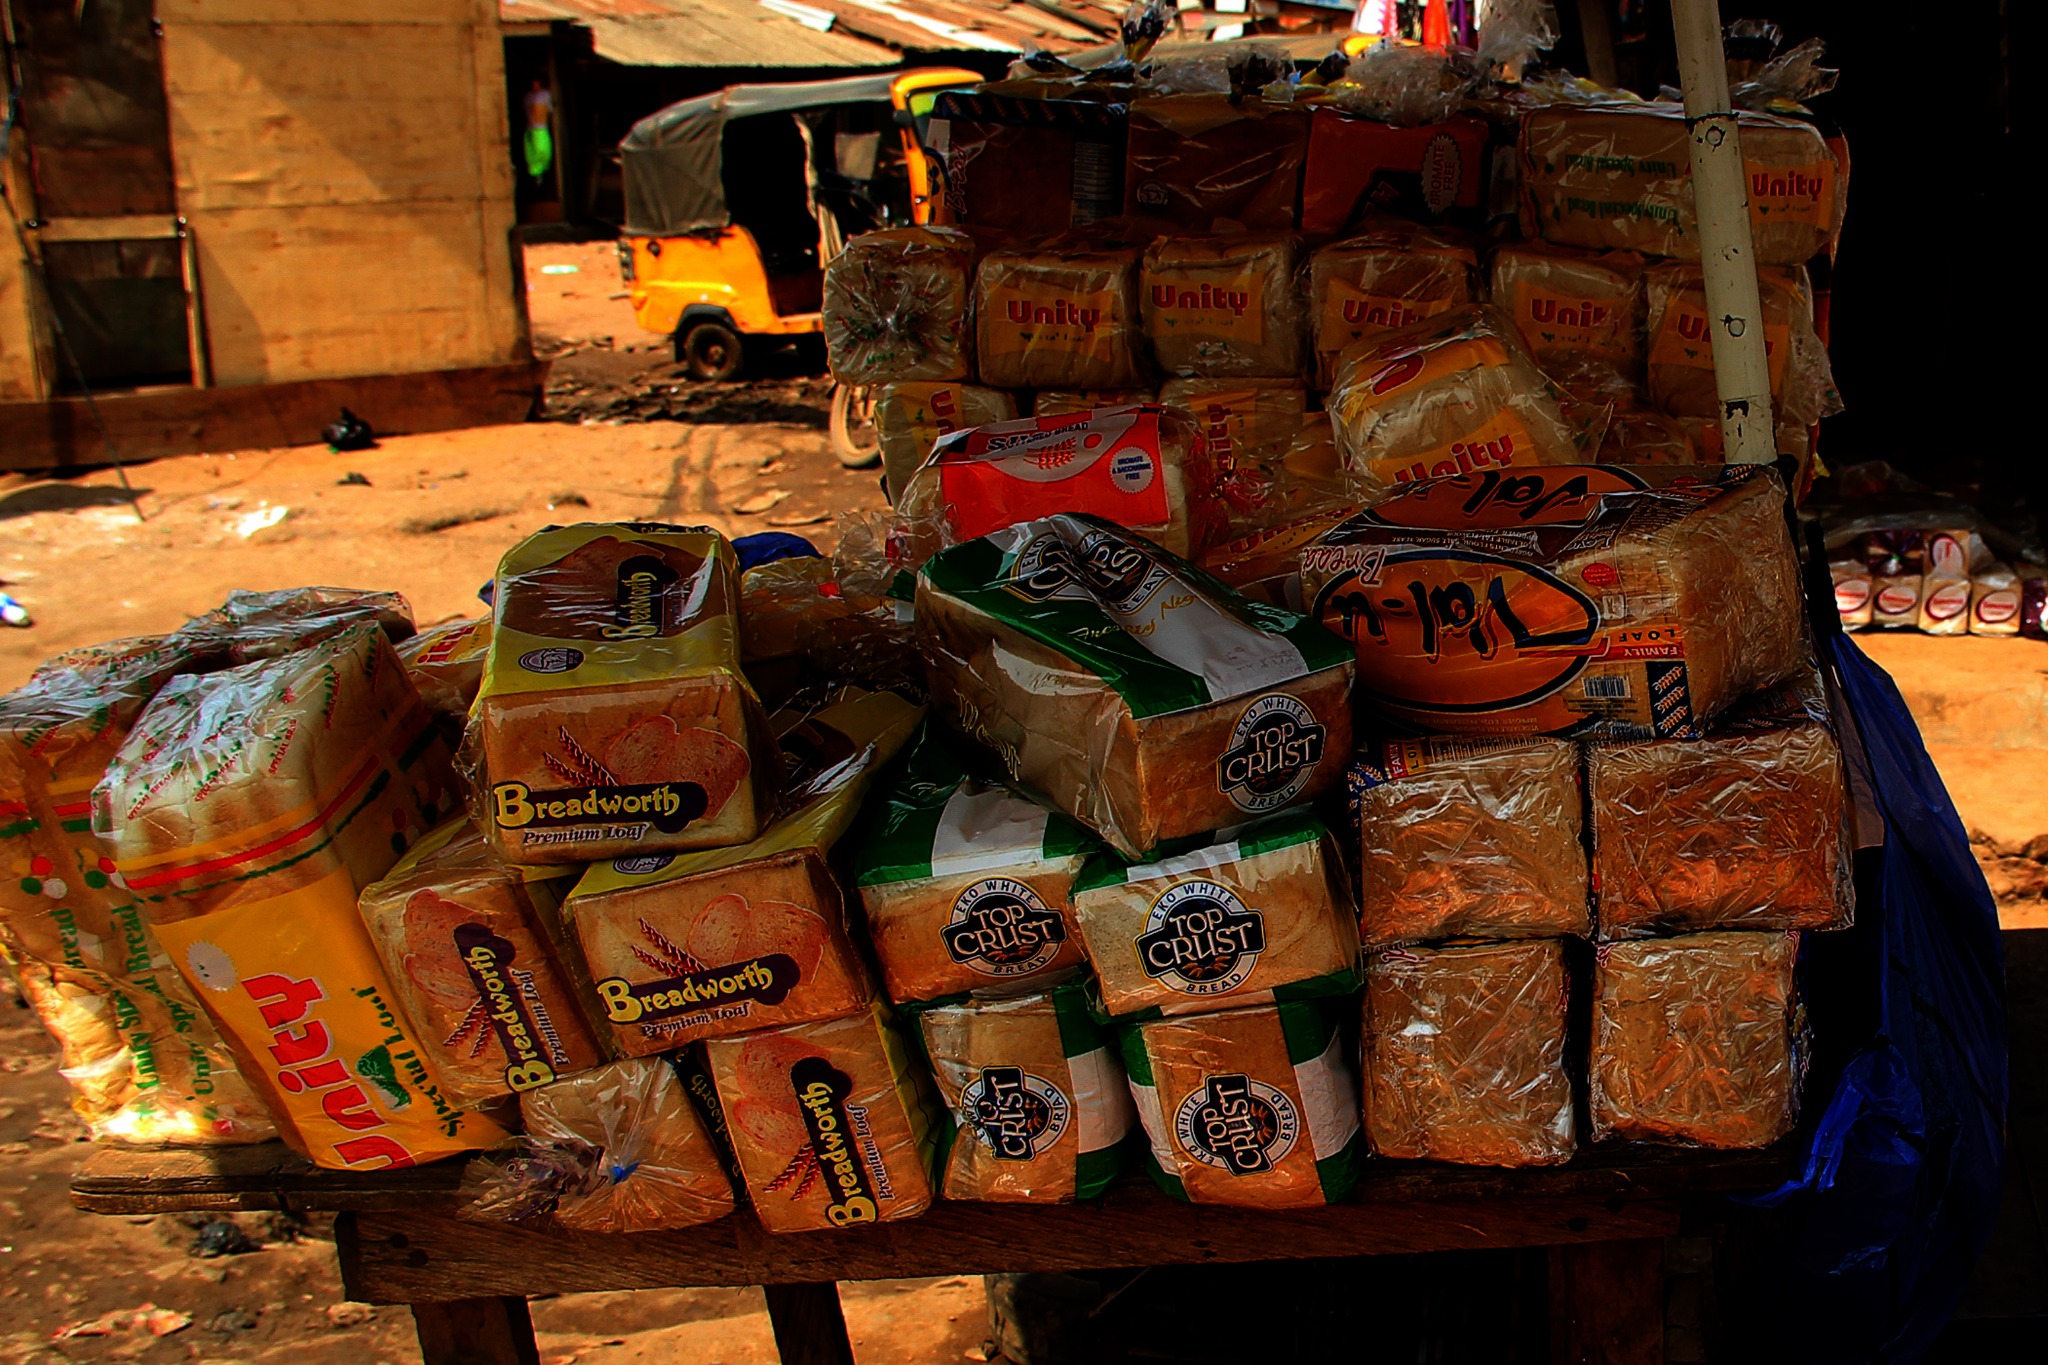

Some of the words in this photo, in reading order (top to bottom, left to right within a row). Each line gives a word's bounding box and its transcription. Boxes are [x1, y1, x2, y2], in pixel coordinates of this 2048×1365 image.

[1430, 144, 1445, 206] BROMATE
[1443, 161, 1456, 191] FREE
[1751, 171, 1823, 202] Unity
[1007, 298, 1101, 332] Unity
[1151, 282, 1249, 316] Unity
[1341, 300, 1427, 328] Unit
[1531, 298, 1619, 330] Unit
[1207, 403, 1233, 473] nity
[1125, 473, 1140, 481] FREE
[1022, 539, 1047, 568] EKO
[1301, 546, 1387, 588] Bread
[600, 571, 659, 638] Breadworth
[1330, 576, 1591, 663] Val-u
[1618, 628, 1676, 642] LOAF
[1623, 646, 1679, 657] FAMILY
[1236, 708, 1257, 737] EKO
[1262, 698, 1306, 719] WHITE
[1249, 722, 1295, 752] TOP
[1226, 733, 1317, 782] CRUST
[494, 782, 681, 828] Breadworth
[1247, 785, 1296, 807] BREAD
[522, 827, 600, 844] Premium
[605, 823, 648, 840] Loaf
[955, 888, 979, 914] EKO
[985, 880, 1035, 903] WHITE
[1152, 892, 1176, 921] EKO
[1183, 883, 1235, 906] WHITE
[971, 904, 1025, 930] TOP
[1168, 908, 1223, 937] TOP
[953, 918, 1055, 955] CRUST
[1148, 921, 1254, 968] CRUST
[992, 956, 1046, 974] BREAD
[1186, 973, 1241, 993] BREAD
[512, 968, 541, 1000] Loaf
[598, 961, 775, 1022] Breadworth
[466, 945, 556, 1092] Breadworth
[532, 1003, 571, 1065] Premium
[641, 1013, 711, 1037] Premium
[714, 1001, 752, 1021] Loaf
[847, 1104, 871, 1136] Loaf
[991, 1075, 1028, 1156] CRUST
[1179, 1096, 1200, 1139] WHITE
[1201, 1107, 1232, 1152] TOP
[1215, 1083, 1262, 1169] CRUST
[1270, 1093, 1294, 1141] BREAD
[800, 1080, 879, 1228] Breadworth
[863, 1139, 895, 1200] Premium
[1188, 1145, 1215, 1165] EKO
